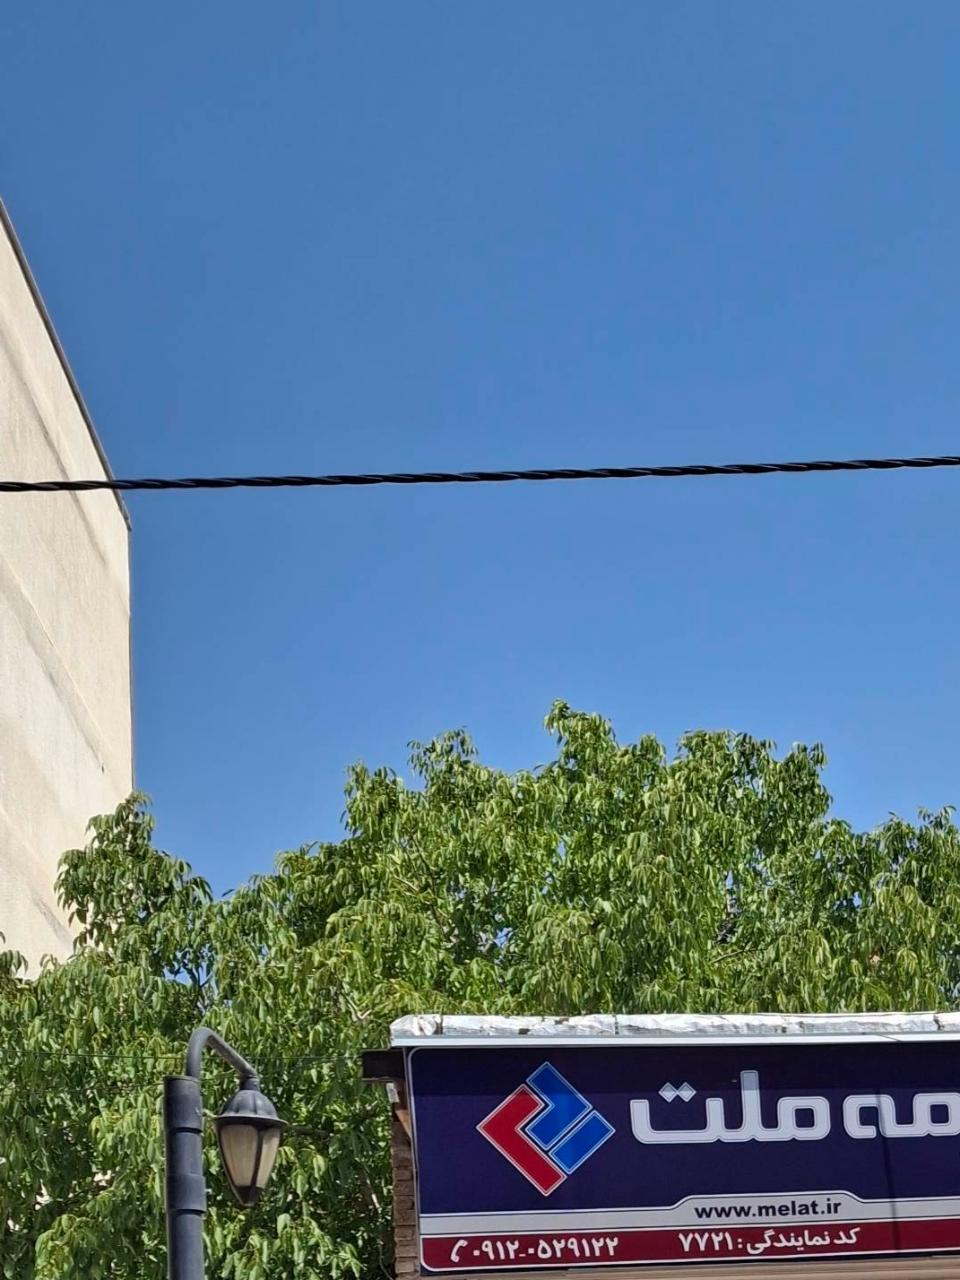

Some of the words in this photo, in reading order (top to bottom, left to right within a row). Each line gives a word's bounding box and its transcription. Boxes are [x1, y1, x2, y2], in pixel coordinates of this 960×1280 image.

[630, 1070, 831, 1144] ملت
[694, 1198, 842, 1219] www.melat.ir
[678, 1231, 734, 1252] ۷۷۲۱
[833, 1227, 861, 1245] کد
